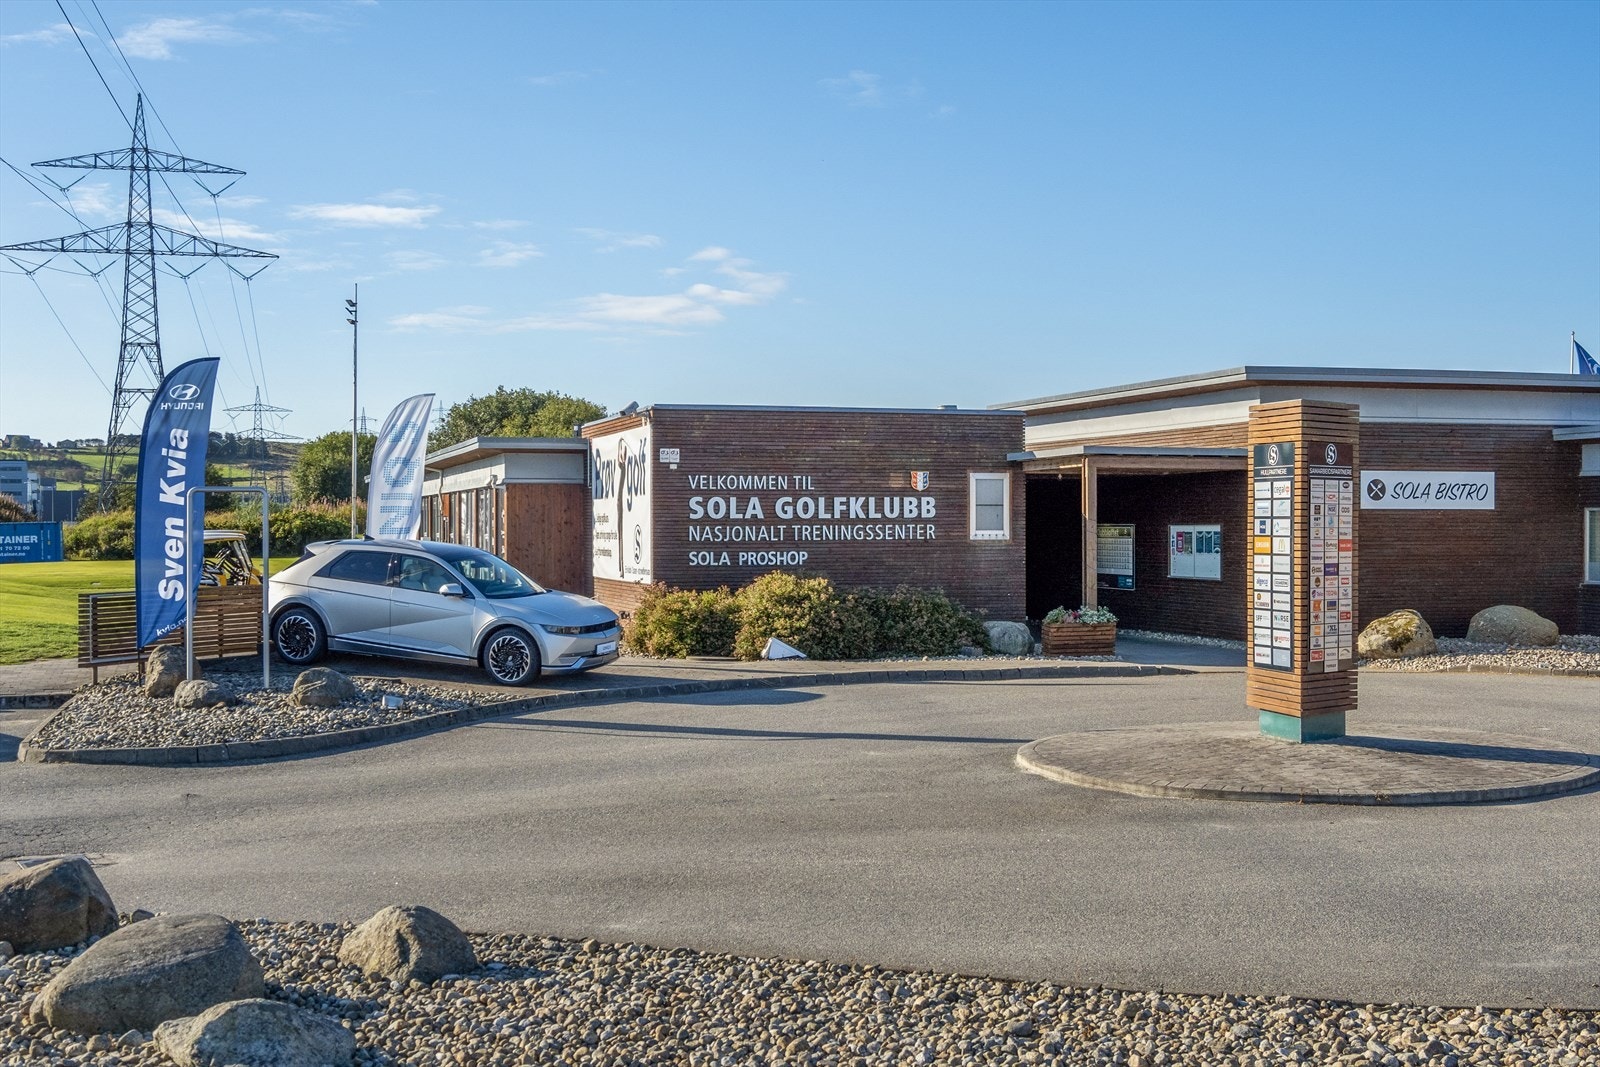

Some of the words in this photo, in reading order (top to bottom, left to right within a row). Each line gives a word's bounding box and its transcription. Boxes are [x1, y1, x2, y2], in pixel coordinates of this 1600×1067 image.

[160, 402, 204, 410] HYUNDAI
[159, 428, 189, 506] Kvia
[626, 437, 647, 512] golf
[688, 475, 788, 490] VELKOMMEN
[793, 475, 815, 490] TIL
[1390, 481, 1431, 500] SOLA
[1435, 482, 1489, 501] BISTRO
[688, 496, 765, 520] SOLA
[775, 496, 936, 520] GOLFKLUBB
[0, 535, 38, 544] TAINER
[689, 525, 787, 541] NASJONALT
[792, 524, 936, 541] TRENINGSSENTER
[158, 517, 184, 602] Sven
[688, 551, 731, 566] SOLA
[739, 551, 808, 566] PROSHOP
